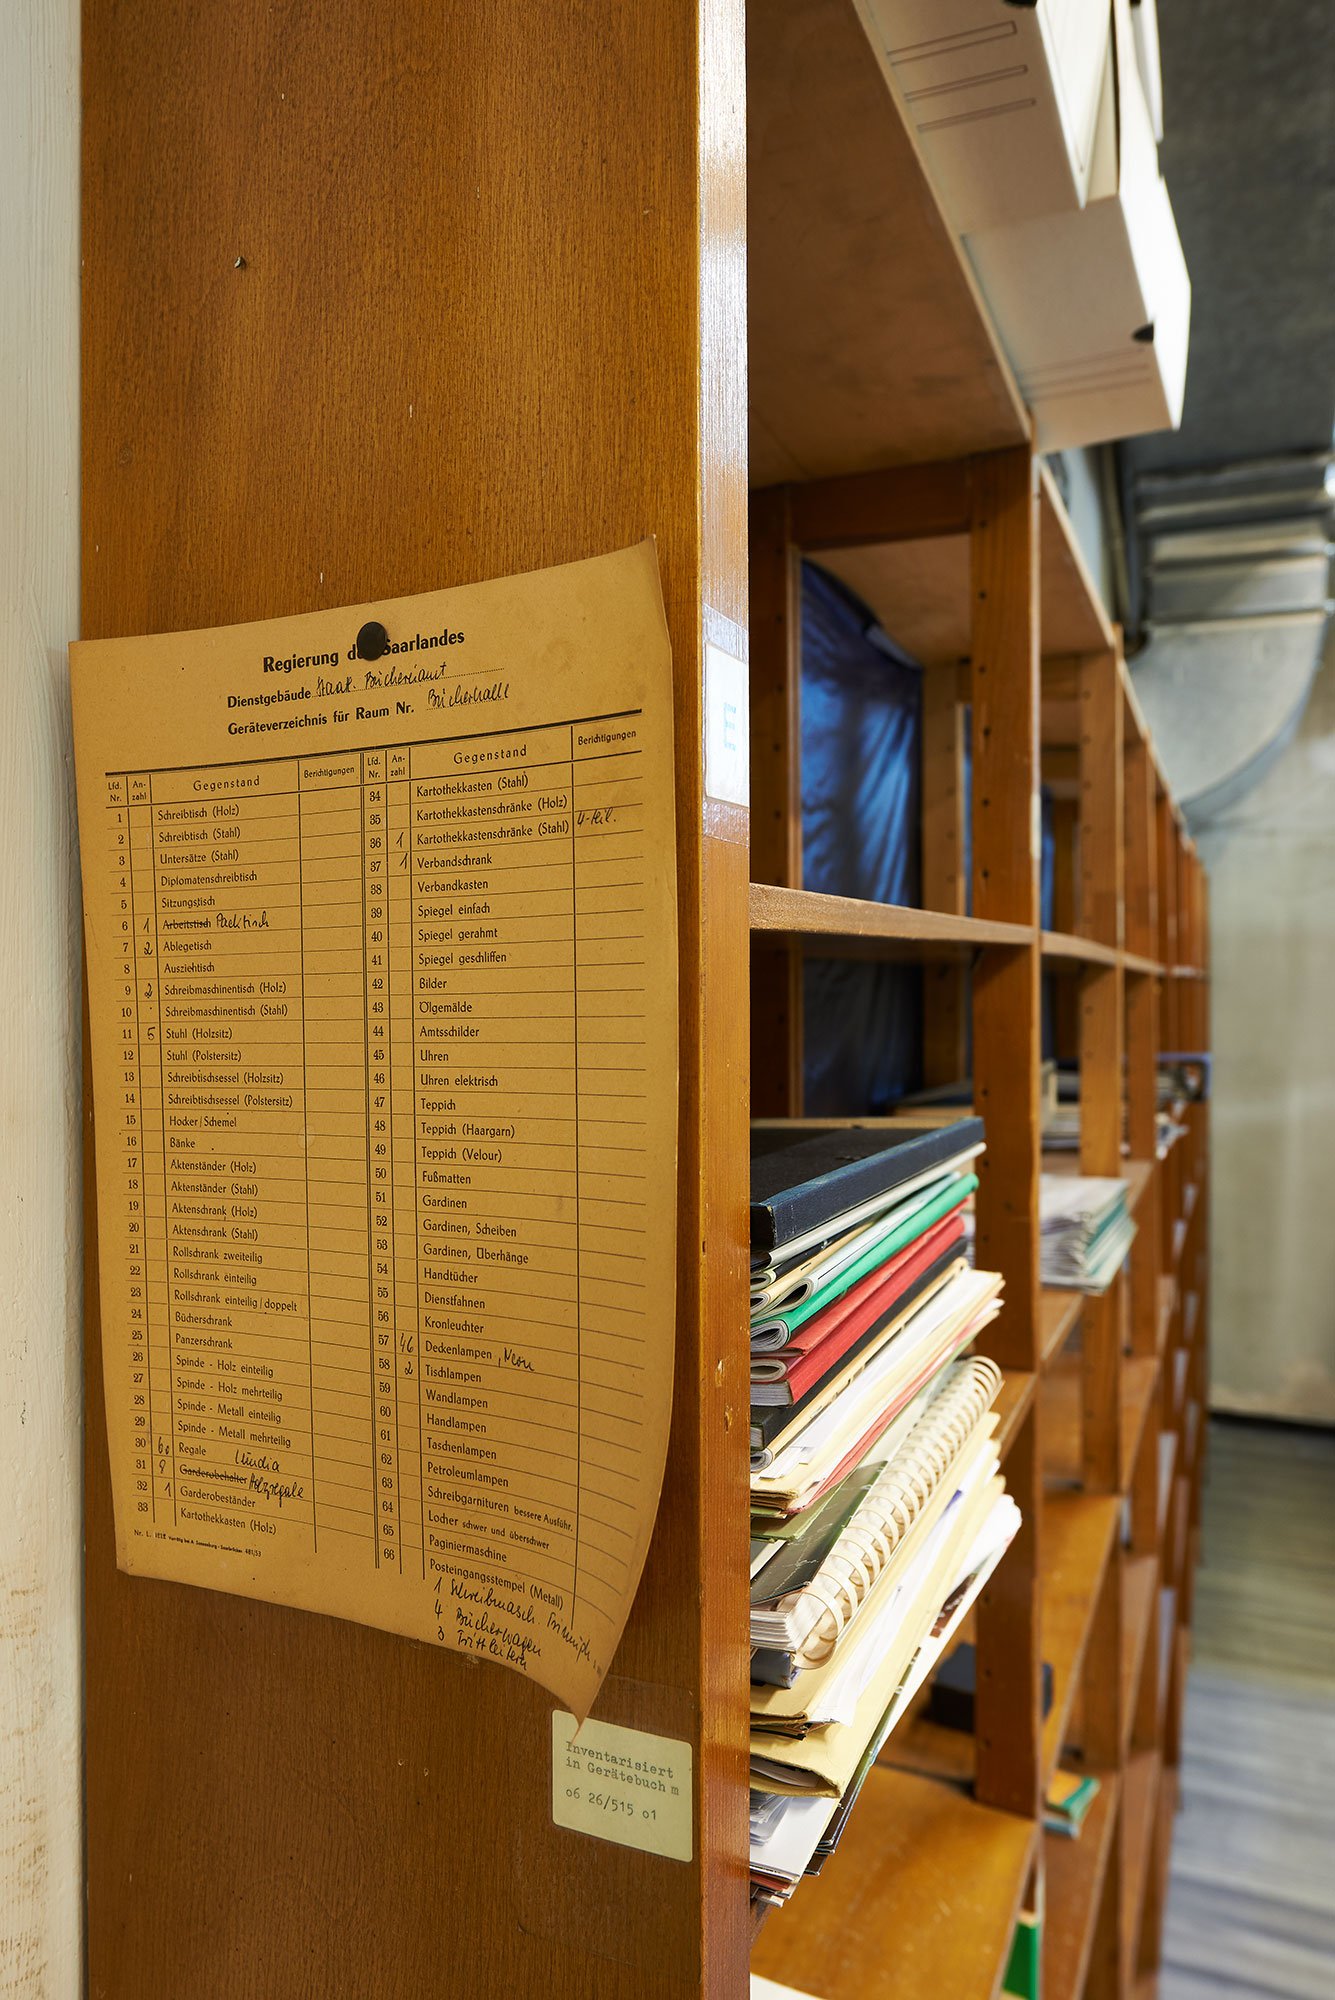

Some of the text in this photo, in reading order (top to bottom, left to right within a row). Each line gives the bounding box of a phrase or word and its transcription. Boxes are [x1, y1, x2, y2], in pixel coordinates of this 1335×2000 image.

[263, 650, 339, 673] Regierung
[228, 688, 311, 708] Dienstgebäude
[228, 701, 414, 735] Geräteverzeichnis für Raum Nr.
[578, 729, 637, 746] Berichtigungen
[367, 756, 380, 765] Lfd.
[392, 754, 405, 763] An-
[453, 745, 528, 764] Gegenstand
[304, 766, 355, 779] Berichtigungen
[369, 770, 380, 778] Nr.
[390, 767, 406, 776] zahl
[108, 782, 122, 790] Lfd.
[132, 781, 146, 789] An-
[193, 777, 260, 792] Gegenstand
[416, 774, 528, 798] Kartothekkasten (Stahl)
[110, 794, 122, 802] Nr.
[132, 792, 147, 801] zahl
[158, 805, 240, 821] Schreibtisch (Holz)
[416, 794, 568, 821] Kartothekkastenschränke (Holz)
[159, 827, 241, 843] Schreibtisch (Stahl)
[417, 820, 570, 845] Kartothekkastenschränke (Stahl)
[160, 850, 239, 865] Untersätze (Stahl)
[417, 854, 492, 869] Verbandschrank
[161, 872, 258, 888] Diplomatenschreibtisch
[418, 880, 488, 892] Verbandkasten
[162, 897, 215, 909] Sitzungstisch
[418, 904, 490, 918] Spiegel einfach
[418, 928, 498, 942] Spiegel gerahmt
[163, 941, 212, 953] Ablegetisch
[418, 952, 507, 966] Spiegel geschliffen
[164, 962, 215, 974] Ausziehtisch
[165, 981, 286, 995] Schreibmaschinentisch (Holz)
[419, 978, 447, 989] Bilder
[165, 1004, 288, 1017] Schreibmaschinentisch (Stahl)
[419, 1002, 472, 1014] Ölgemälde
[166, 1027, 233, 1040] Stuhl (Holzsitz)
[420, 1026, 480, 1038] Amtsschilder
[167, 1049, 242, 1062] Stuhl (Polstersitz)
[420, 1050, 448, 1062] Uhren
[168, 1071, 284, 1084] Schreibtischsessel (Holzsitz)
[421, 1074, 498, 1086] Uhren elektrisch
[168, 1093, 293, 1107] Schreibtischsessel (Polstersitz)
[422, 1122, 515, 1138] Teppich (Haargarn)
[170, 1137, 196, 1148] Bänke
[422, 1146, 502, 1162] Teppich (Velour)
[170, 1160, 256, 1173] Aktenständer (Holz)
[422, 1171, 472, 1184] Fußmatten
[171, 1181, 258, 1196] Aktenständer (Stahl)
[422, 1195, 467, 1208] Gardinen
[172, 1203, 257, 1218] Aktenschrank (Holz)
[172, 1225, 258, 1240] Aktenschrank (Stahl)
[423, 1219, 517, 1237] Gardinen, Scheiben
[173, 1247, 263, 1264] Rollschrank zweiteilig
[424, 1244, 529, 1264] Gardinen, Überhänge
[174, 1268, 257, 1285] Rollschrank einteilig
[424, 1268, 478, 1284] Handtücher
[175, 1290, 221, 1304] Rollschrank
[425, 1292, 486, 1309] Dienstfahnen
[176, 1312, 233, 1327] Bücherschrank
[425, 1316, 484, 1334] Kronleuchter
[132, 1331, 142, 1340] 25
[176, 1334, 233, 1349] Panzerschrank
[426, 1340, 492, 1360] Deckenlampen
[176, 1356, 274, 1377] Spinde Holz einteilig
[426, 1365, 482, 1383] Tischlampen
[177, 1377, 283, 1400] Spinde Holz mehrteilig
[426, 1390, 488, 1408] Wandlampen
[177, 1399, 281, 1423] Spinde Metall einteilig
[427, 1414, 487, 1433] Handlampen
[178, 1421, 291, 1448] Spinde Metall mehrteilig
[179, 1442, 207, 1456] Regale
[427, 1438, 497, 1460] Taschenlampen
[428, 1462, 509, 1487] Petroleumlampen
[180, 1486, 256, 1508] Garderobeständer
[428, 1486, 573, 1532] Schreibgarnituren bessere Ausführ.
[181, 1508, 277, 1535] Kartothekkasten (Holz)
[429, 1510, 550, 1550] Locher schwer und überschwer
[384, 1549, 395, 1560] 66
[429, 1534, 507, 1562] Paginiermaschine
[430, 1559, 563, 1610] Posteingangsstempel (Metall)
[566, 1741, 674, 1779] Inventarisiert
[566, 1757, 581, 1769] in
[587, 1763, 666, 1792] Gerätebuch
[588, 1792, 634, 1816] 26/515
